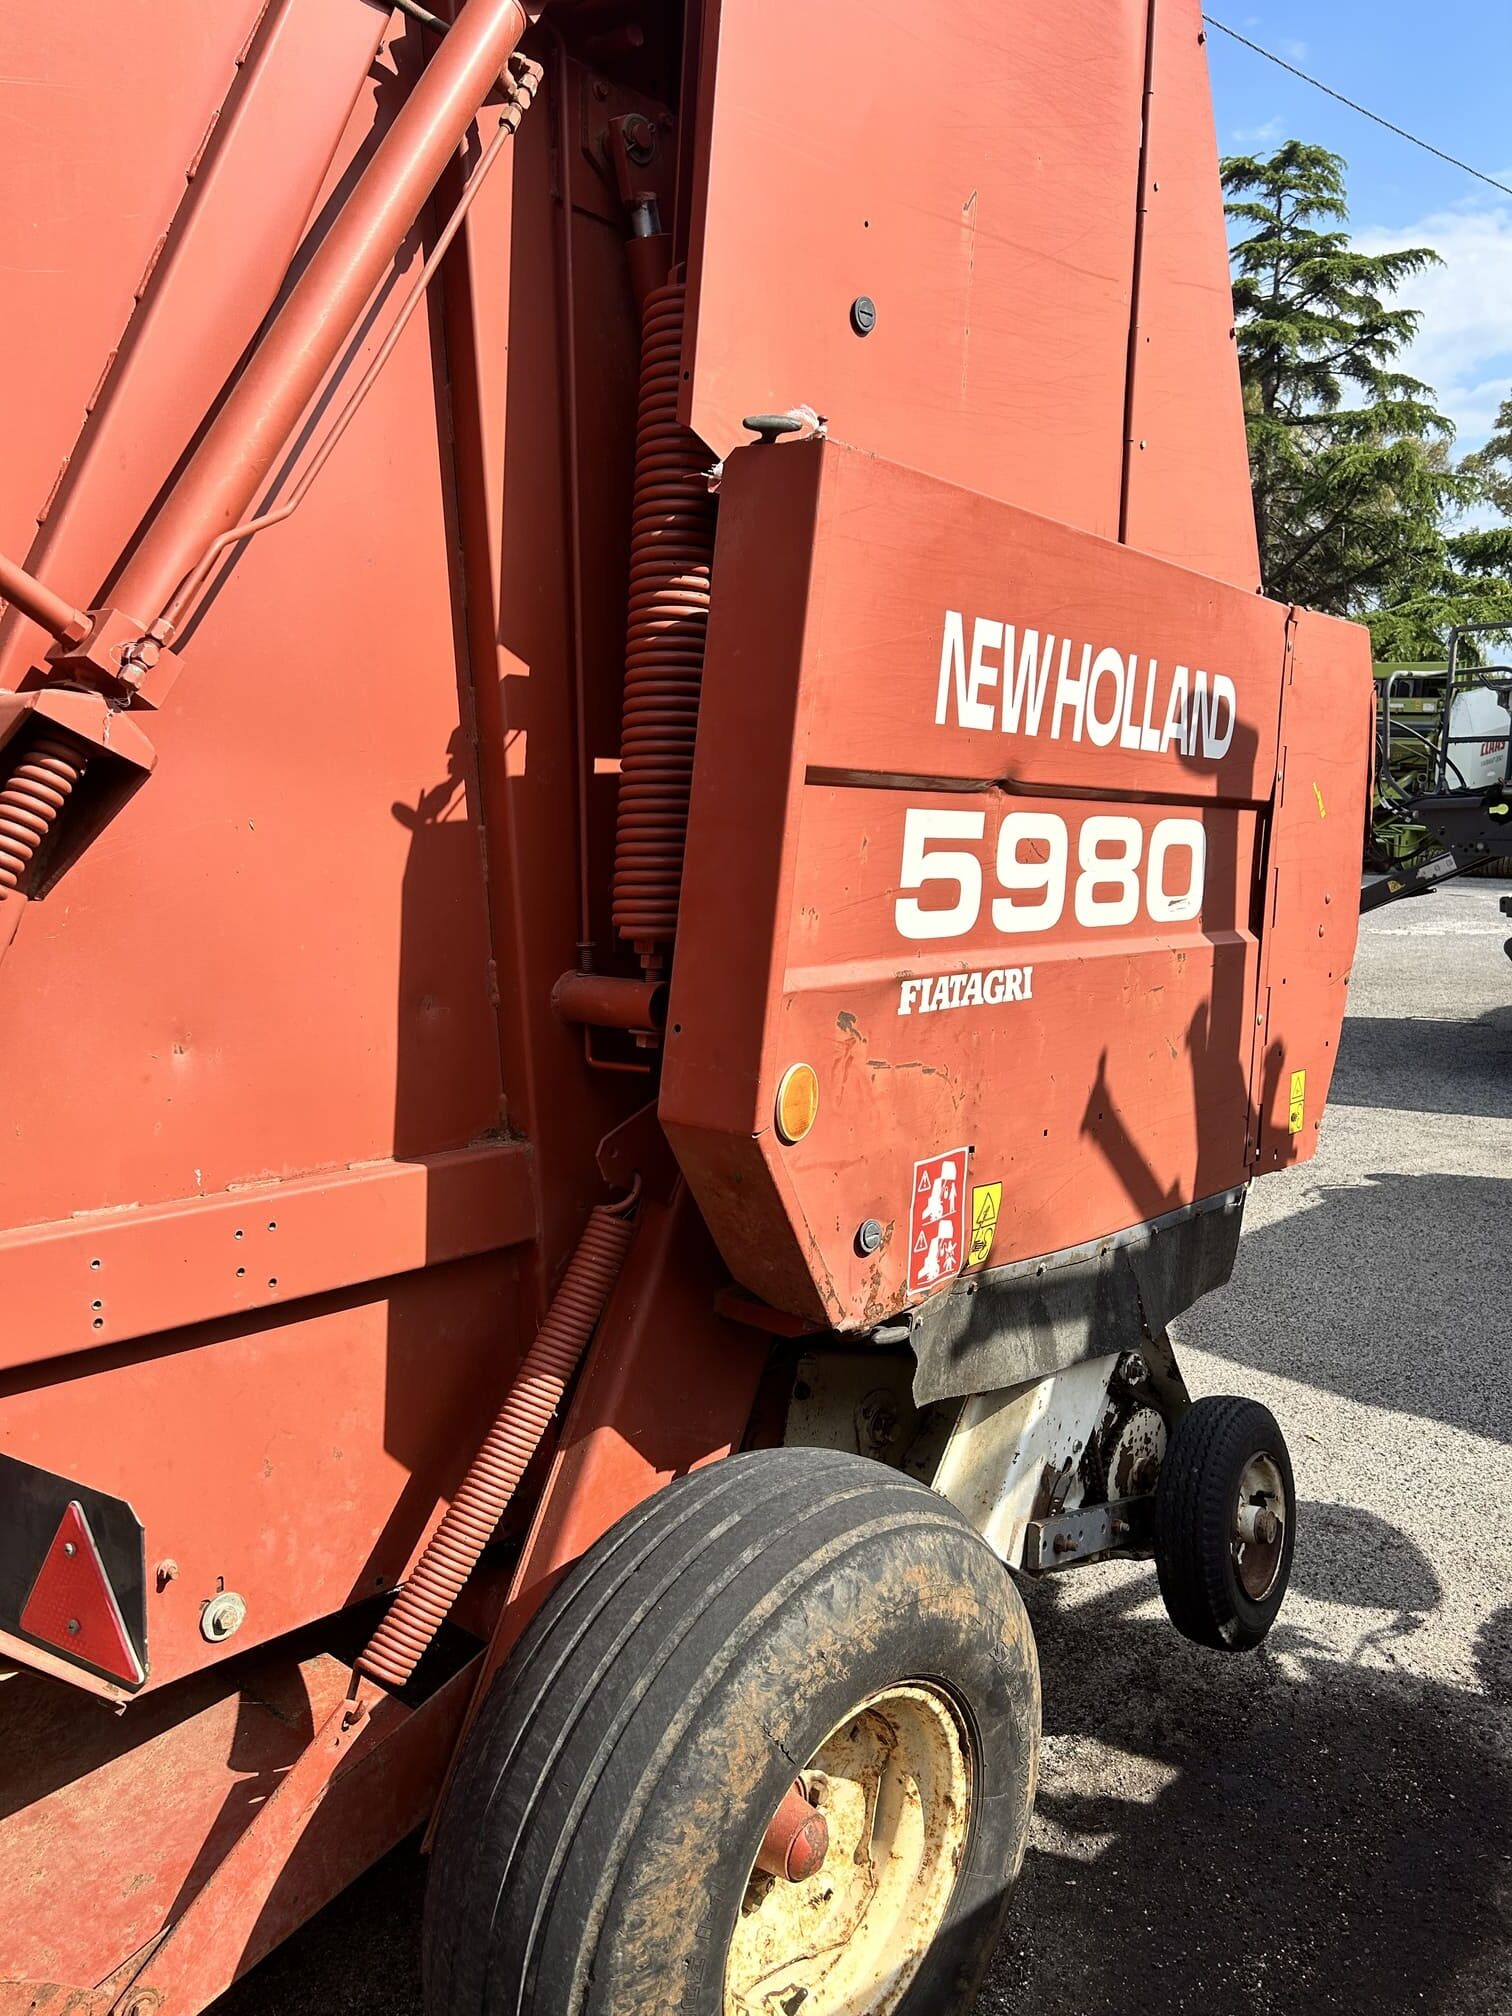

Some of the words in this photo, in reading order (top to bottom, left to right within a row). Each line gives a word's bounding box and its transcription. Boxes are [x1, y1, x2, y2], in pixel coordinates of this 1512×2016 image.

[935, 609, 1056, 737] NEW
[1051, 638, 1237, 760] HOLLAND
[894, 808, 1207, 940] 5980
[897, 966, 1034, 1015] FIATAGRI
